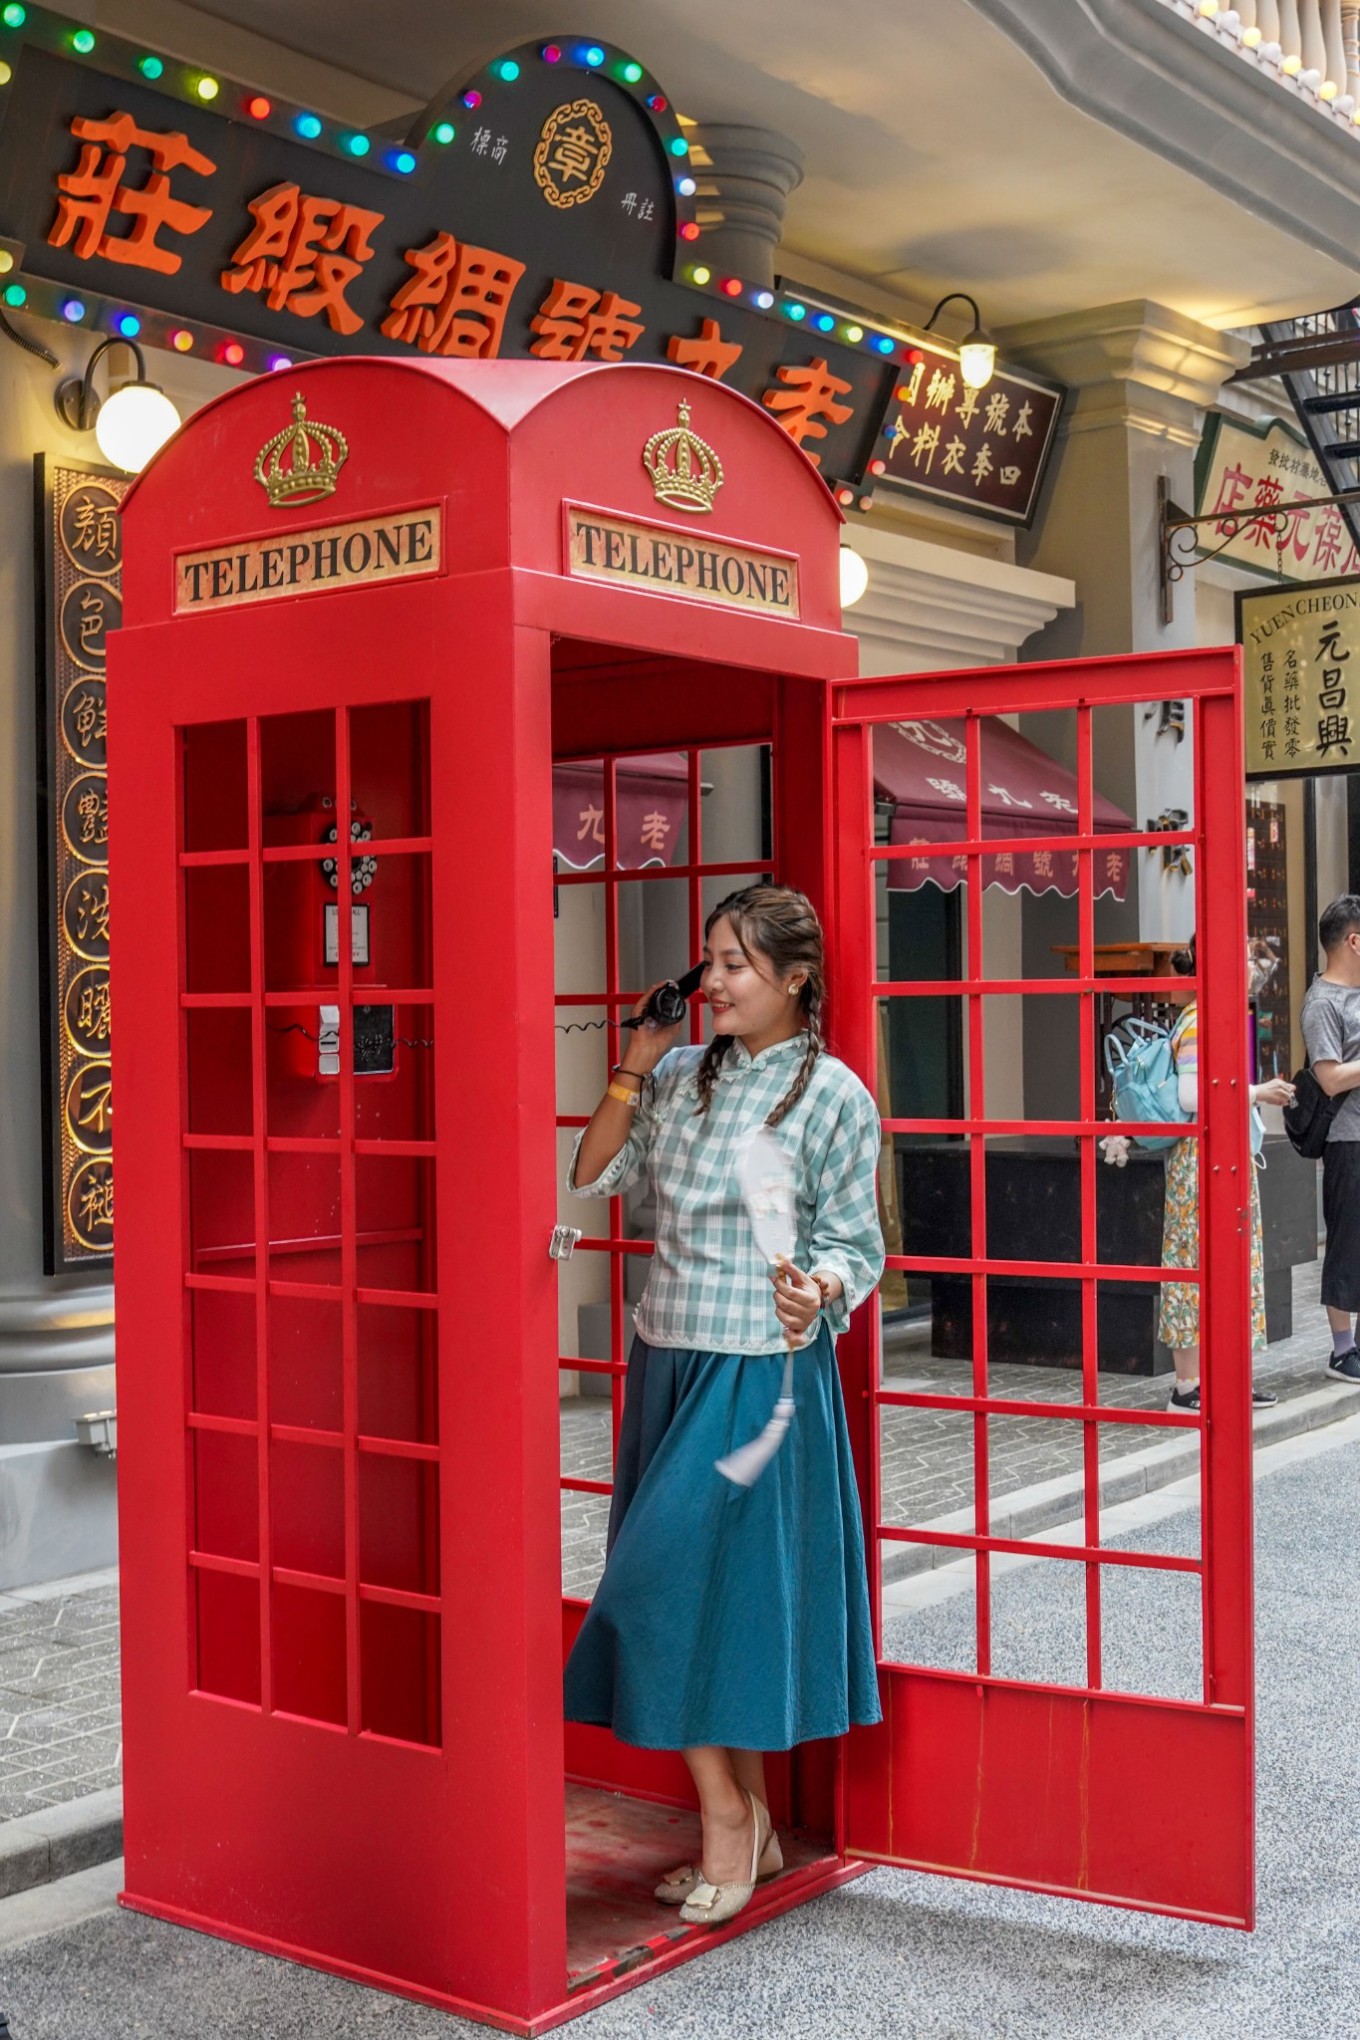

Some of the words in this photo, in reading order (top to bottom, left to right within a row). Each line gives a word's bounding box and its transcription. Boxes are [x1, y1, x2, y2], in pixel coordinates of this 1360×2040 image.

[548, 126, 599, 183] 章
[184, 519, 433, 603] TELEPHONE
[576, 522, 790, 606] TELEPHONE
[1314, 620, 1352, 759] 元昌興
